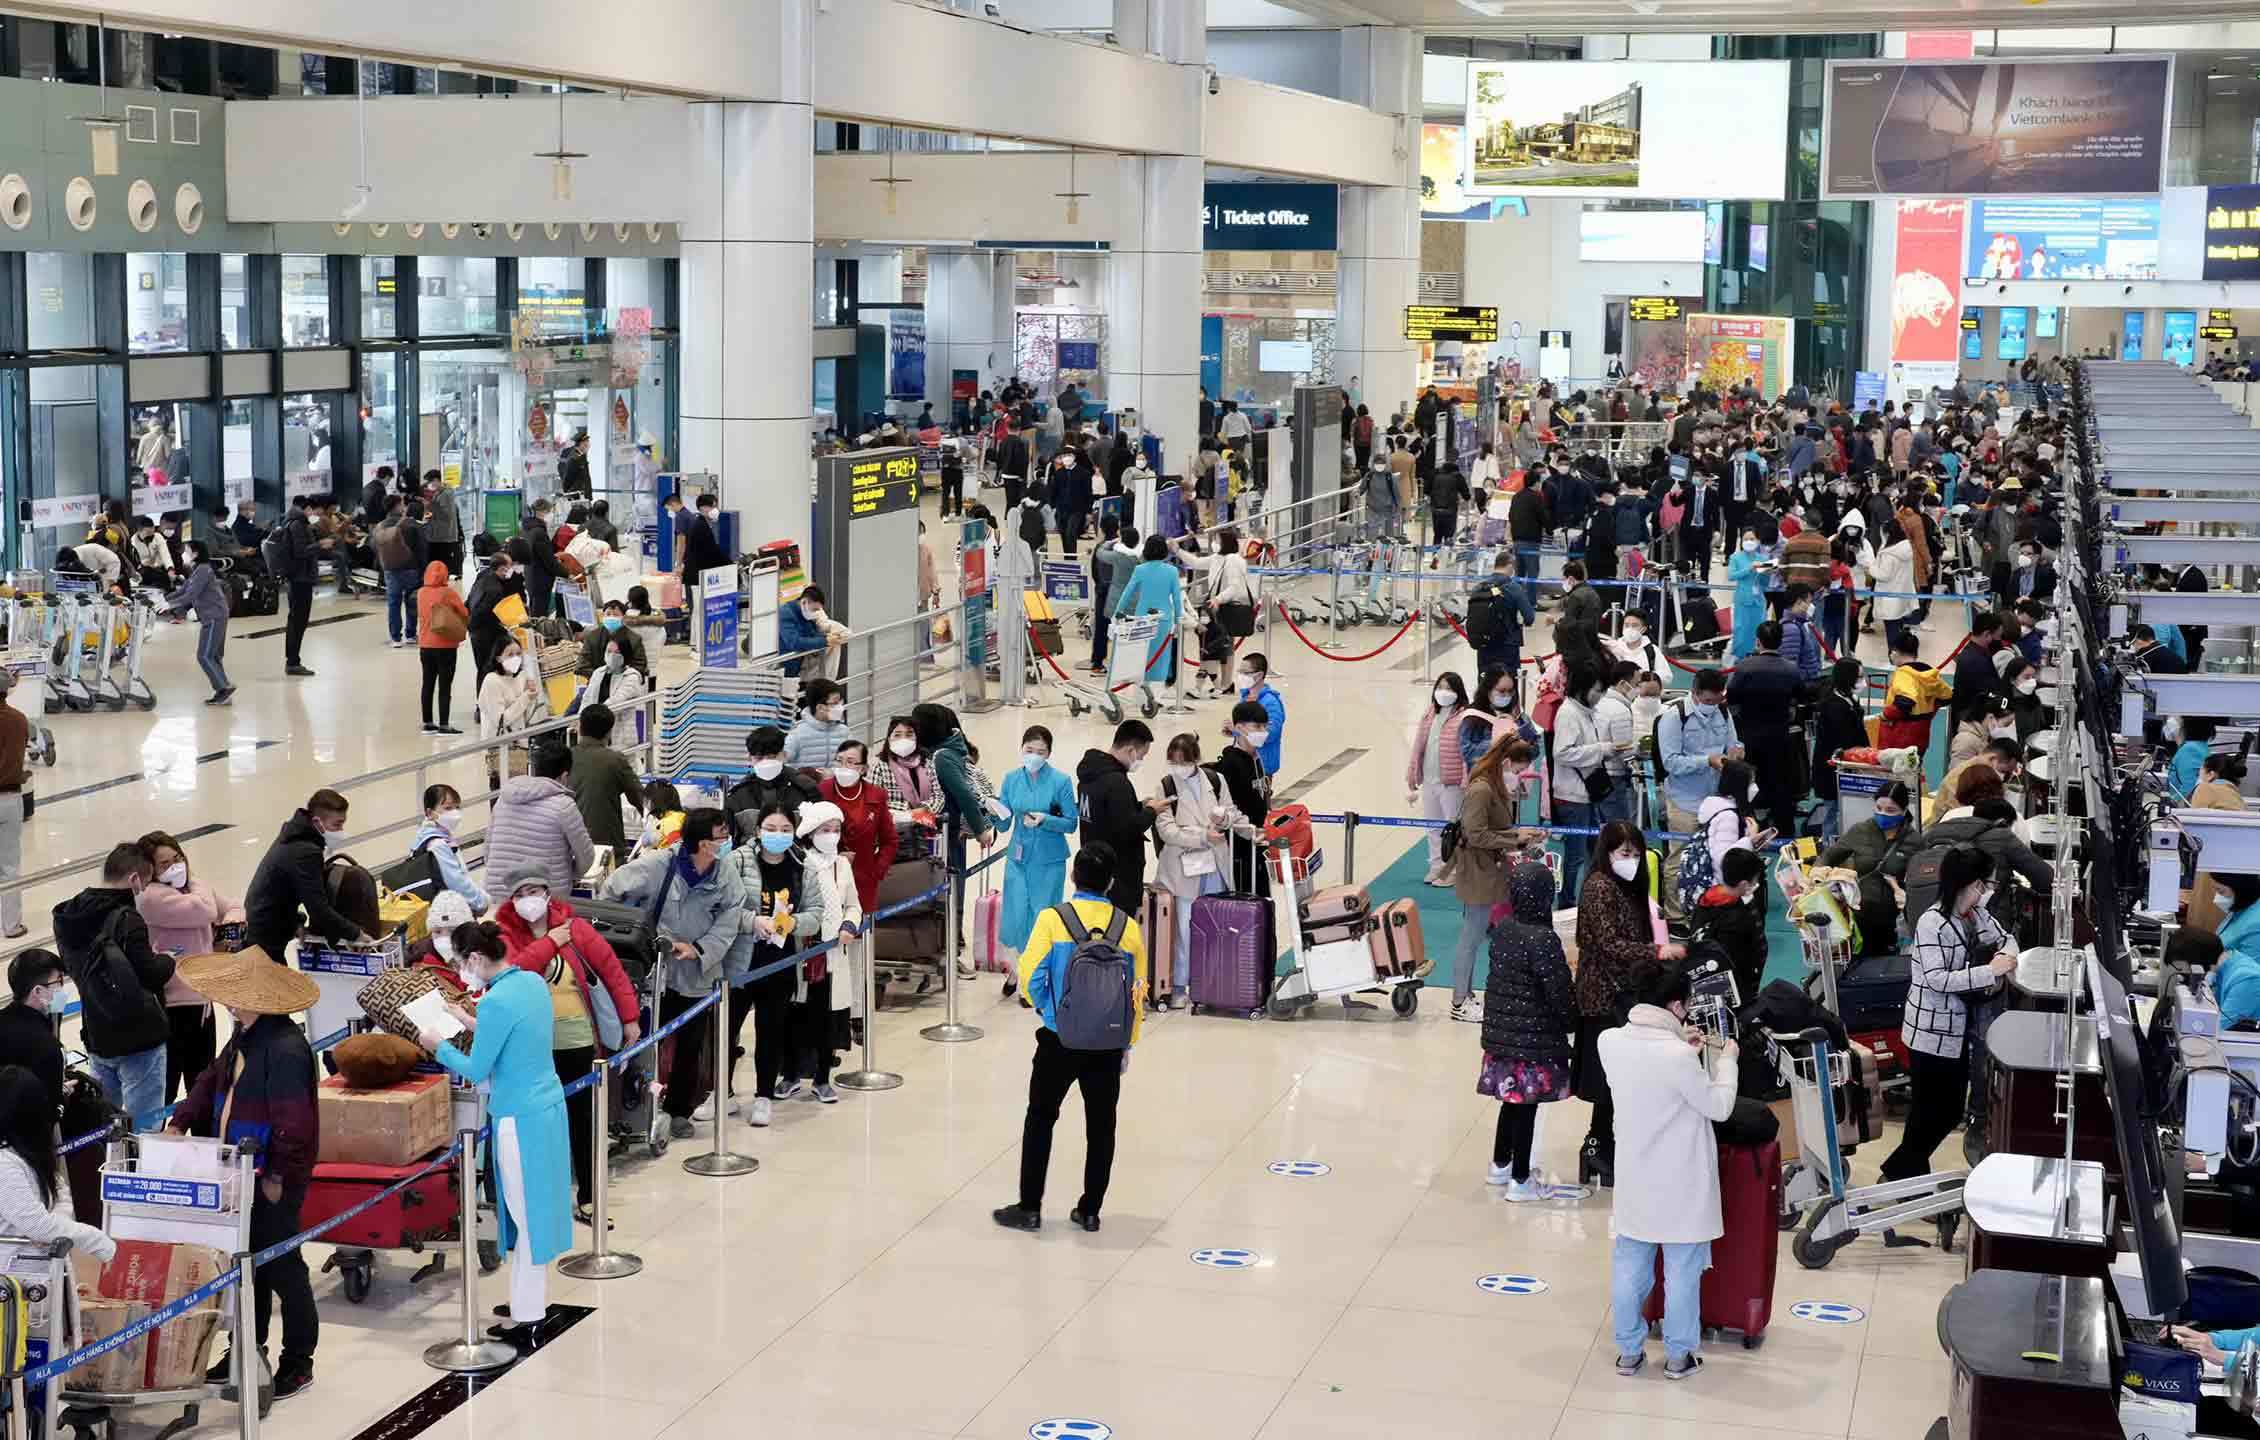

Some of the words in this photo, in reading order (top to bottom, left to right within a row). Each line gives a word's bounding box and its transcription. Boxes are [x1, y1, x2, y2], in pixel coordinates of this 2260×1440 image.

[1223, 210, 1266, 225] Ticket
[1267, 210, 1309, 225] Office
[2144, 1378, 2181, 1390] VIAGS
